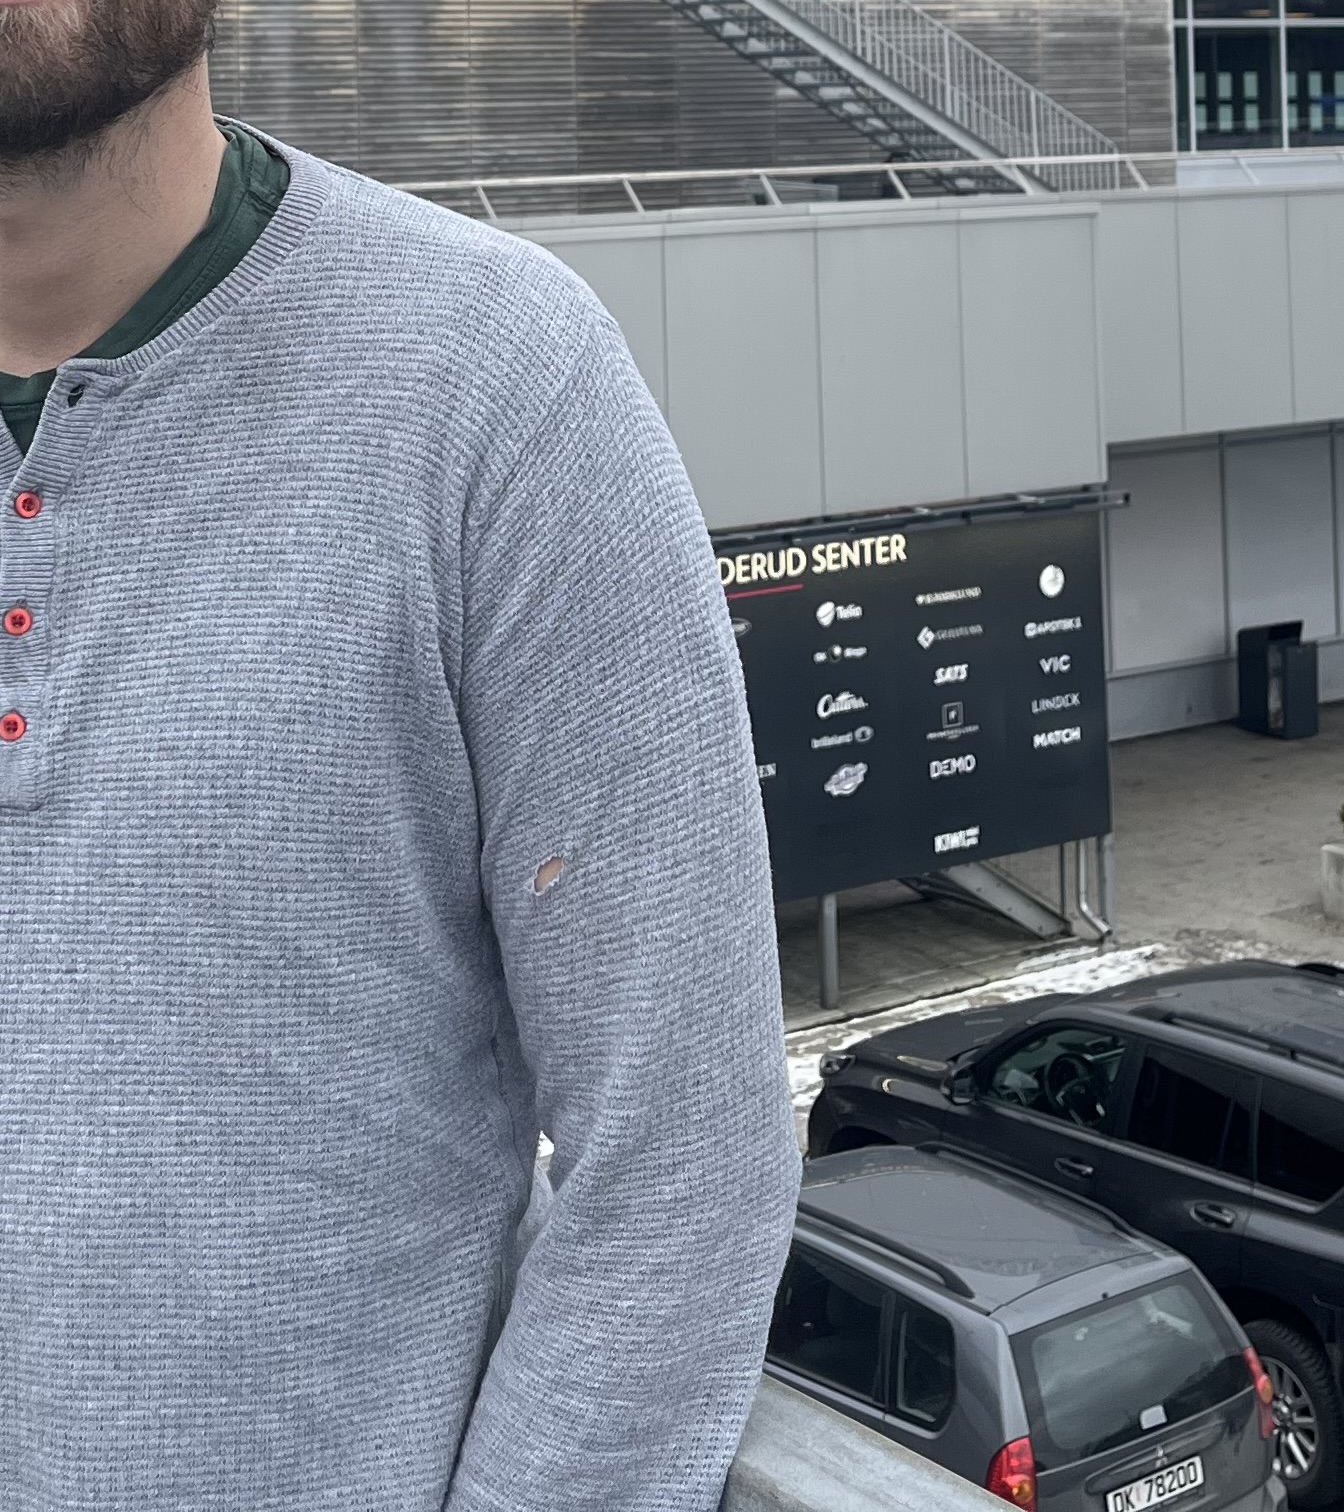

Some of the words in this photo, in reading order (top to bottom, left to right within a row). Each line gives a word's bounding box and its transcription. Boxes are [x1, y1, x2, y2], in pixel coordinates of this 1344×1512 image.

[717, 546, 807, 587] DERUD
[811, 533, 907, 575] SENTER
[1039, 654, 1071, 674] VIC
[1033, 726, 1081, 749] MATCH
[929, 754, 976, 779] DEMO
[1144, 1461, 1197, 1503] 78200
